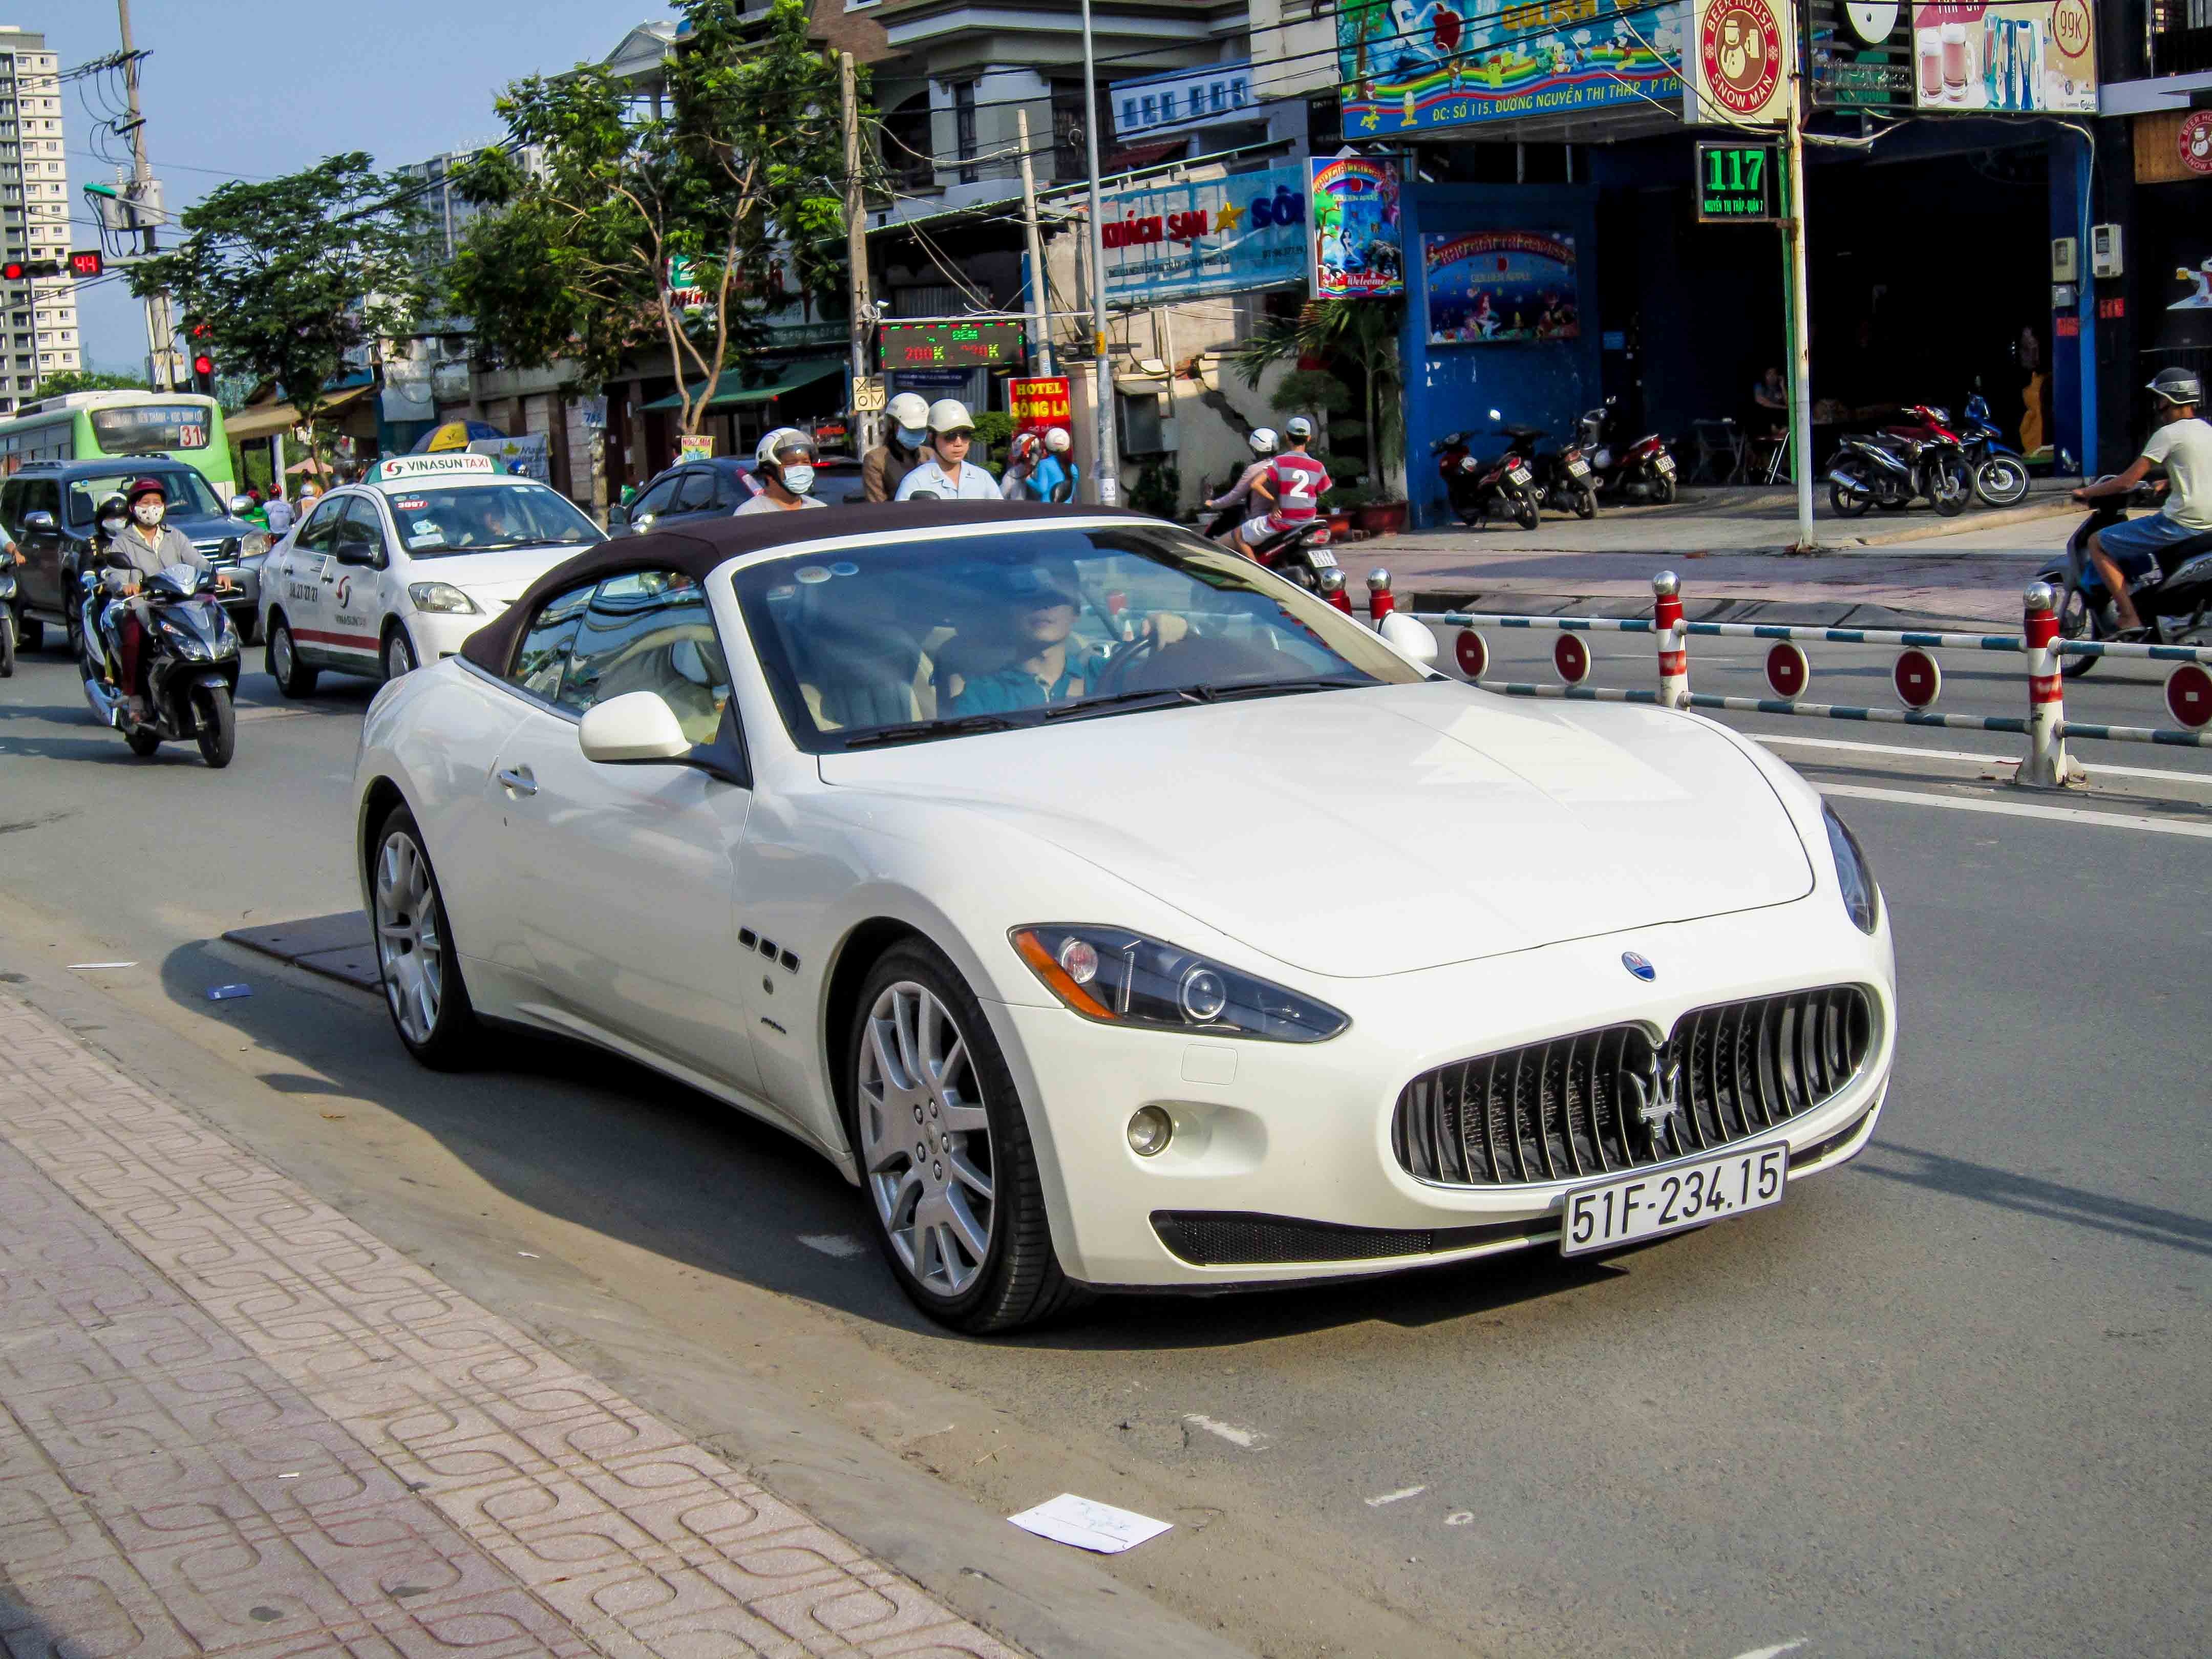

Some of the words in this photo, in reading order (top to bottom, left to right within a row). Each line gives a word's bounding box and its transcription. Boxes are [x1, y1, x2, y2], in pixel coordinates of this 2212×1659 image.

[2060, 11, 2083, 40] 99K
[1536, 83, 1582, 108] NGUYỄN
[1587, 87, 1605, 103] THỊ
[1712, 73, 1746, 107] SNOW
[1750, 74, 1773, 106] MAN
[1706, 151, 1764, 190] 117
[2184, 154, 2207, 170] SNOW
[1168, 209, 1208, 248] SẠN
[73, 256, 98, 272] 44
[1346, 275, 1385, 287] Welcome
[856, 378, 883, 392] XE
[1016, 382, 1062, 396] HOTEL
[1011, 398, 1050, 418] SÔNG
[1052, 400, 1069, 417] LA
[183, 426, 202, 445] 31
[408, 459, 462, 472] VINASUN
[463, 458, 488, 469] TAXI
[1290, 470, 1311, 498] 2
[1572, 1152, 1780, 1244] 51F-234.15
